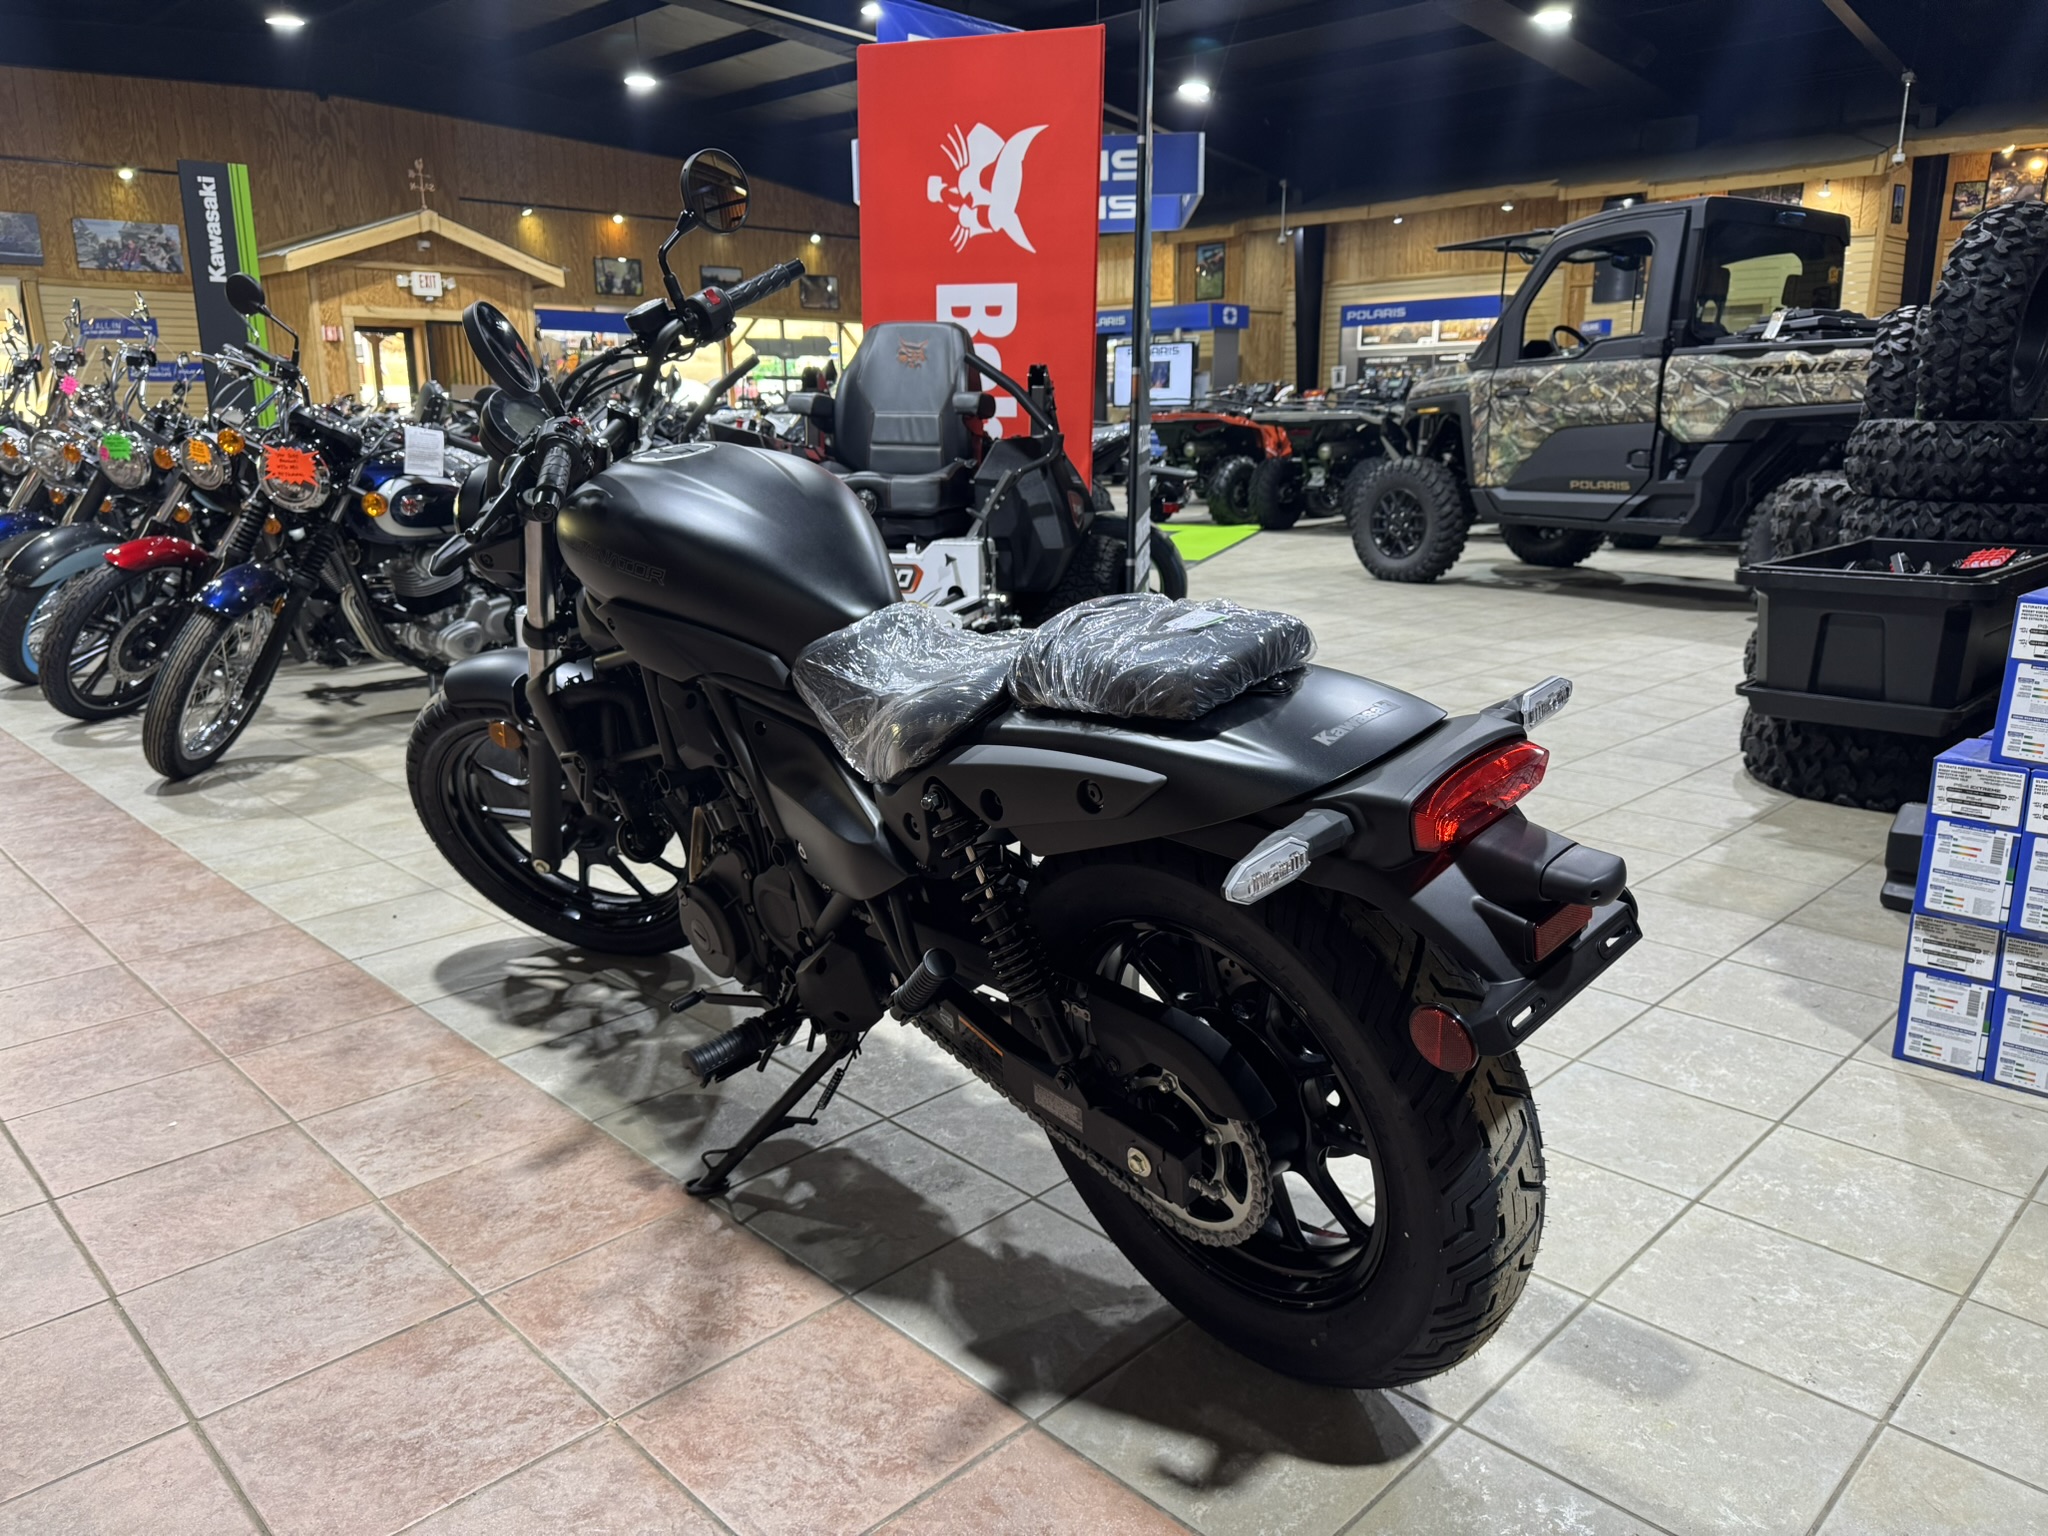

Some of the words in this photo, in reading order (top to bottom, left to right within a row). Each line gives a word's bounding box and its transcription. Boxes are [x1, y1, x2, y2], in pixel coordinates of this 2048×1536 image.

[197, 176, 227, 283] Kawasaki
[419, 274, 436, 288] EXIT
[1346, 306, 1407, 321] POLARIS
[1569, 480, 1630, 491] POLARIS
[1311, 699, 1401, 747] Kawasaki
